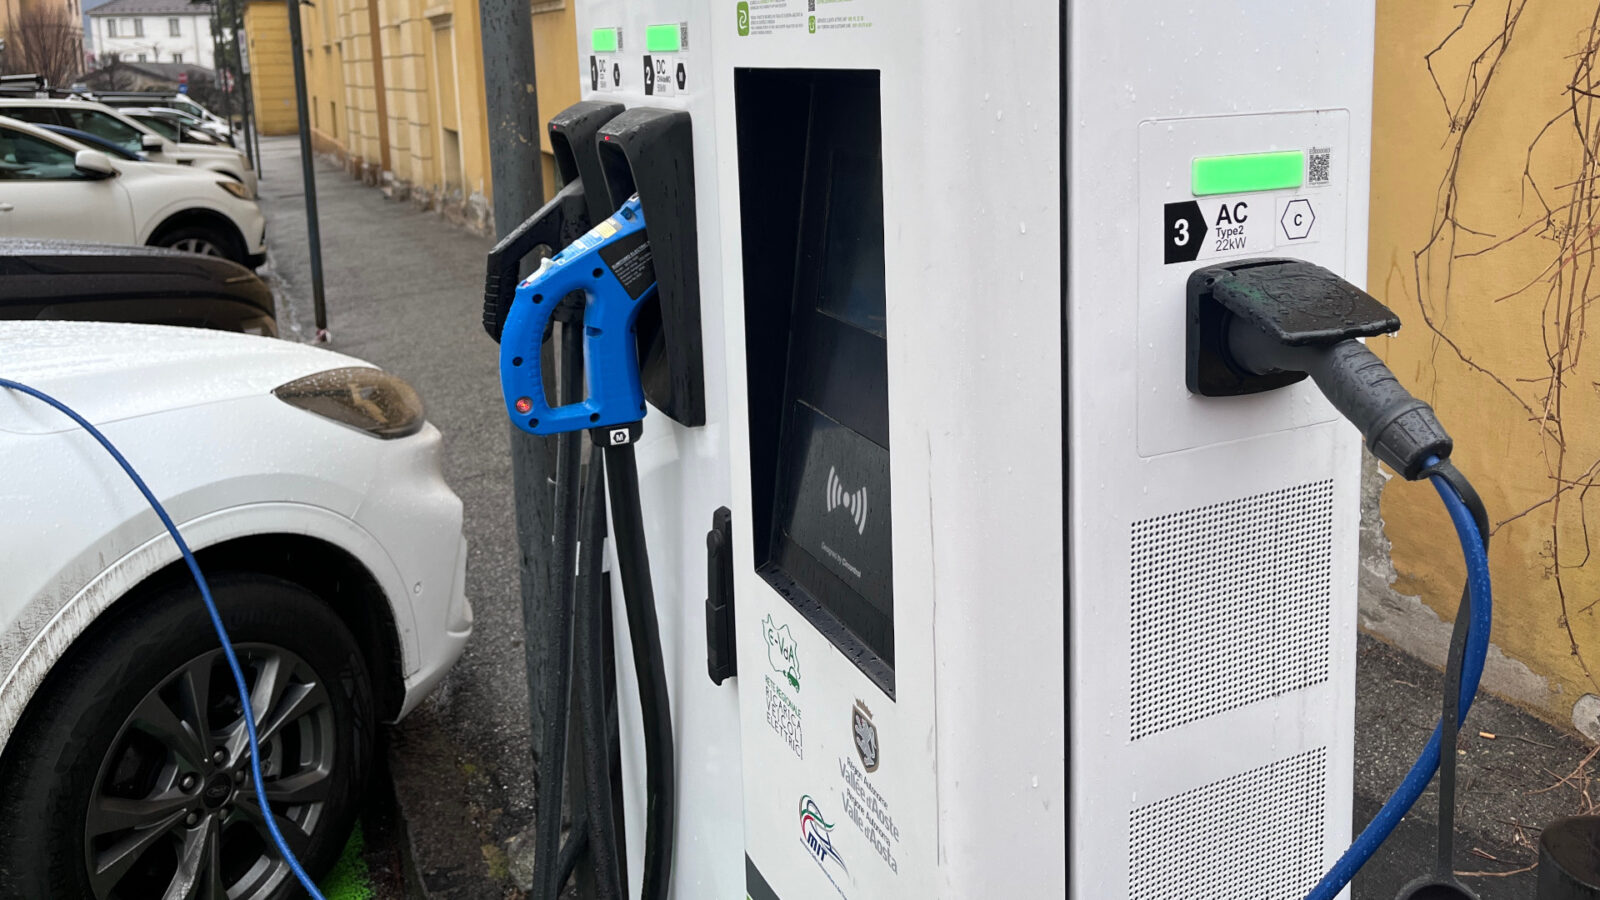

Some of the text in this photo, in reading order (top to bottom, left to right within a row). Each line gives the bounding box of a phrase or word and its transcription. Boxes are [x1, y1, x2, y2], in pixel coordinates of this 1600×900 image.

[592, 65, 596, 81] 1
[599, 59, 606, 73] DC
[646, 66, 652, 84] 2
[656, 59, 665, 74] DC
[1216, 201, 1248, 226] AC
[1294, 214, 1303, 226] C
[1174, 218, 1190, 247] 3
[1216, 225, 1244, 240] Type2
[1216, 237, 1247, 252] 22kW
[615, 433, 624, 442] M
[766, 685, 802, 731] RICARICA
[766, 695, 802, 747] VEICOLI
[766, 711, 803, 761] ELETTRICI
[839, 757, 899, 843] Vallée d'Aoste
[841, 791, 898, 876] Valle d'Aosta
